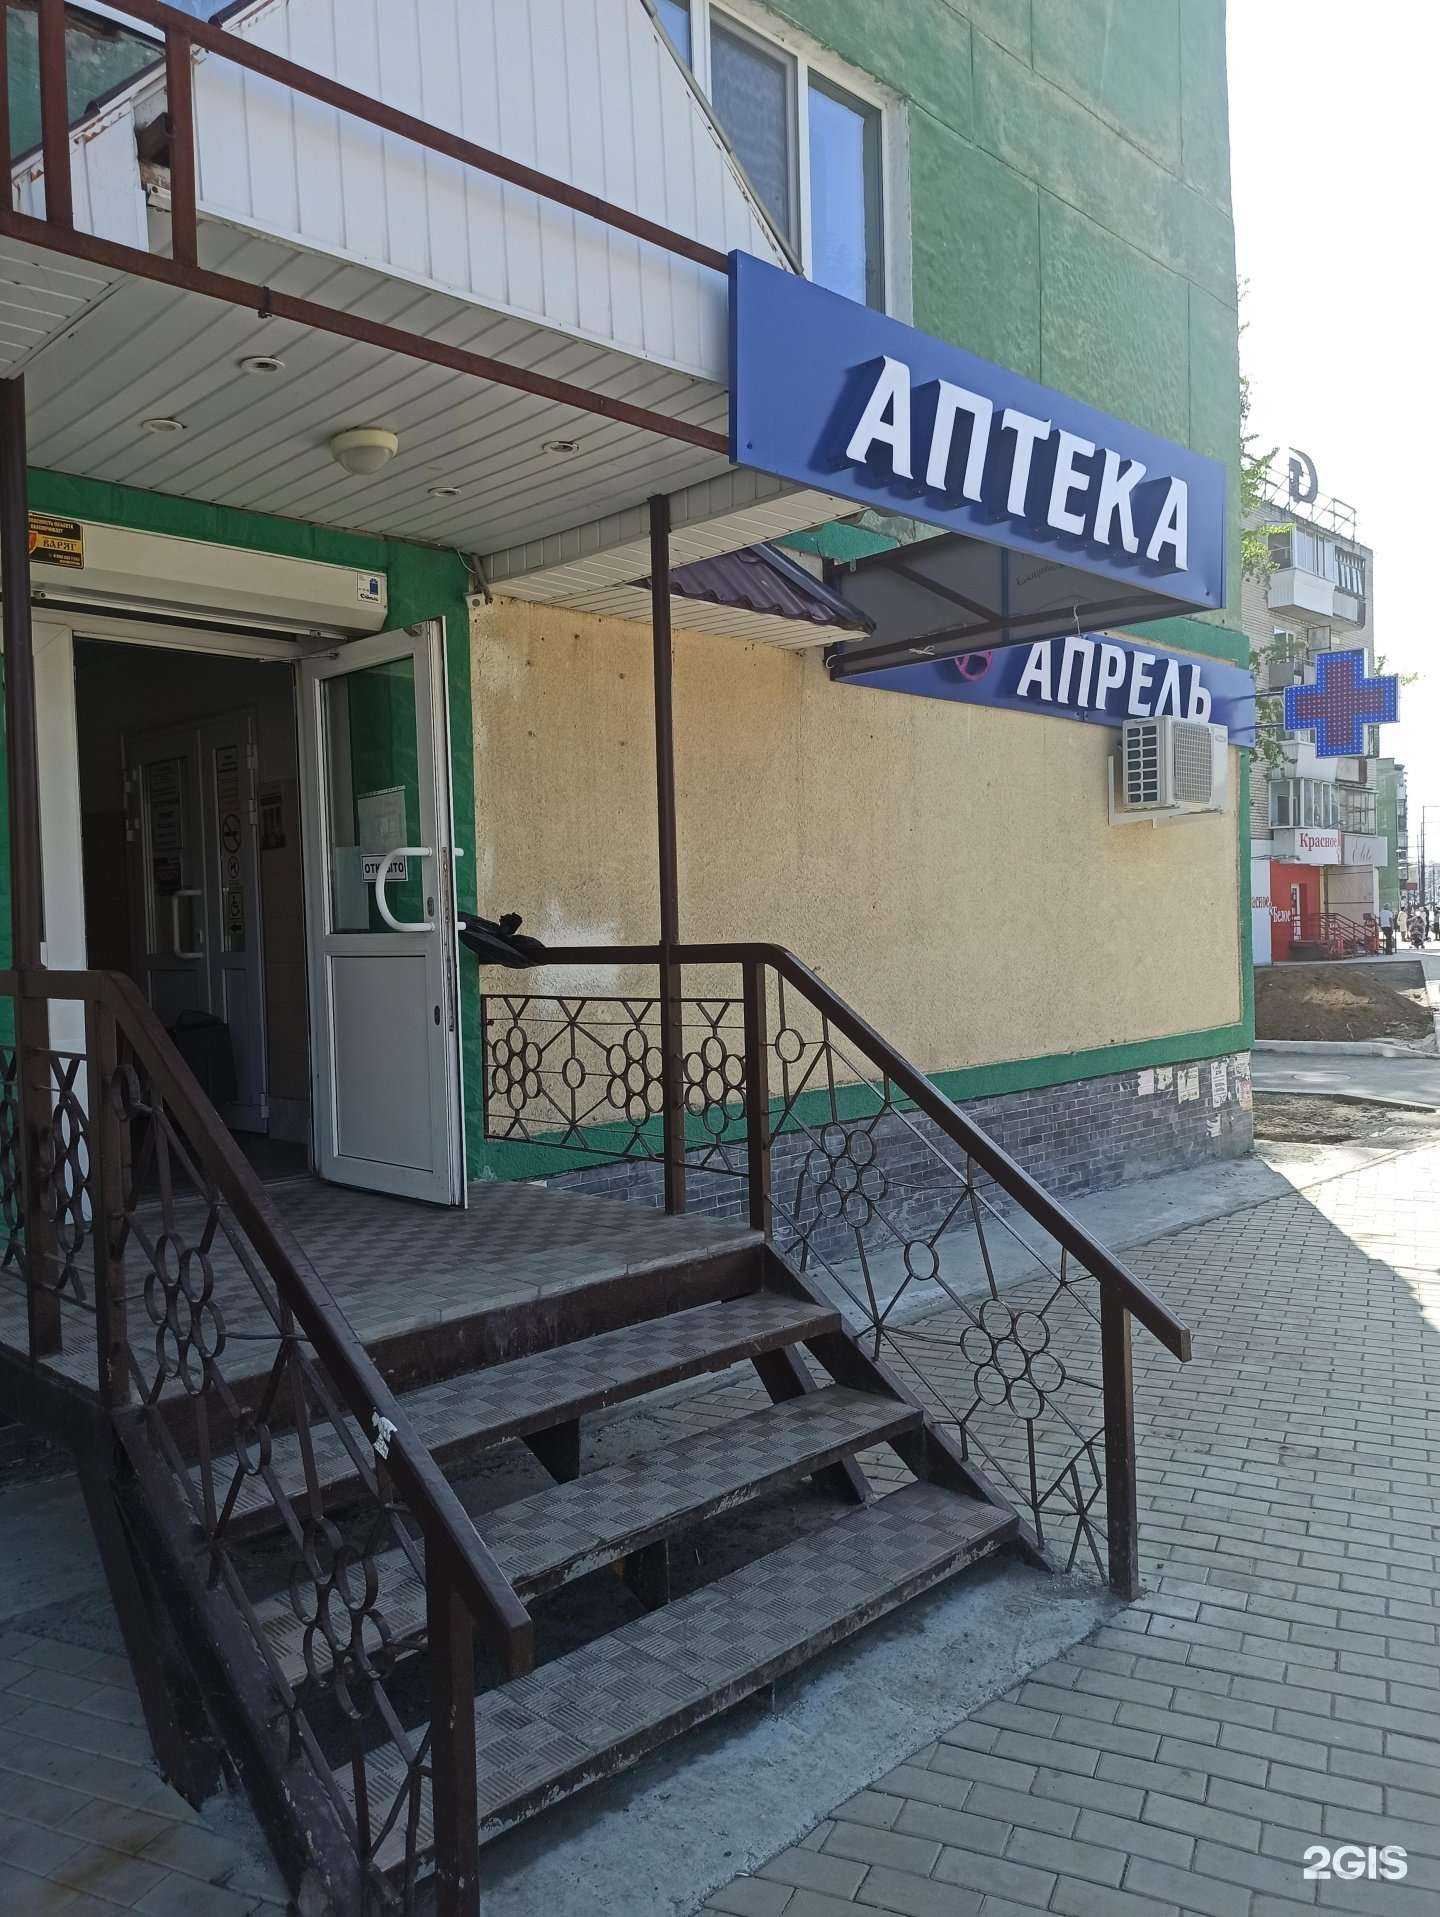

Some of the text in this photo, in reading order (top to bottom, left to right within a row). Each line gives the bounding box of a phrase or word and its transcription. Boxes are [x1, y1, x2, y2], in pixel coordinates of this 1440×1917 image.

[846, 354, 1189, 571] АПТЕКА
[1016, 636, 1212, 724] АПРЕЛЬ
[365, 863, 404, 873] ОТКЫТО
[1300, 832, 1338, 851] Красное
